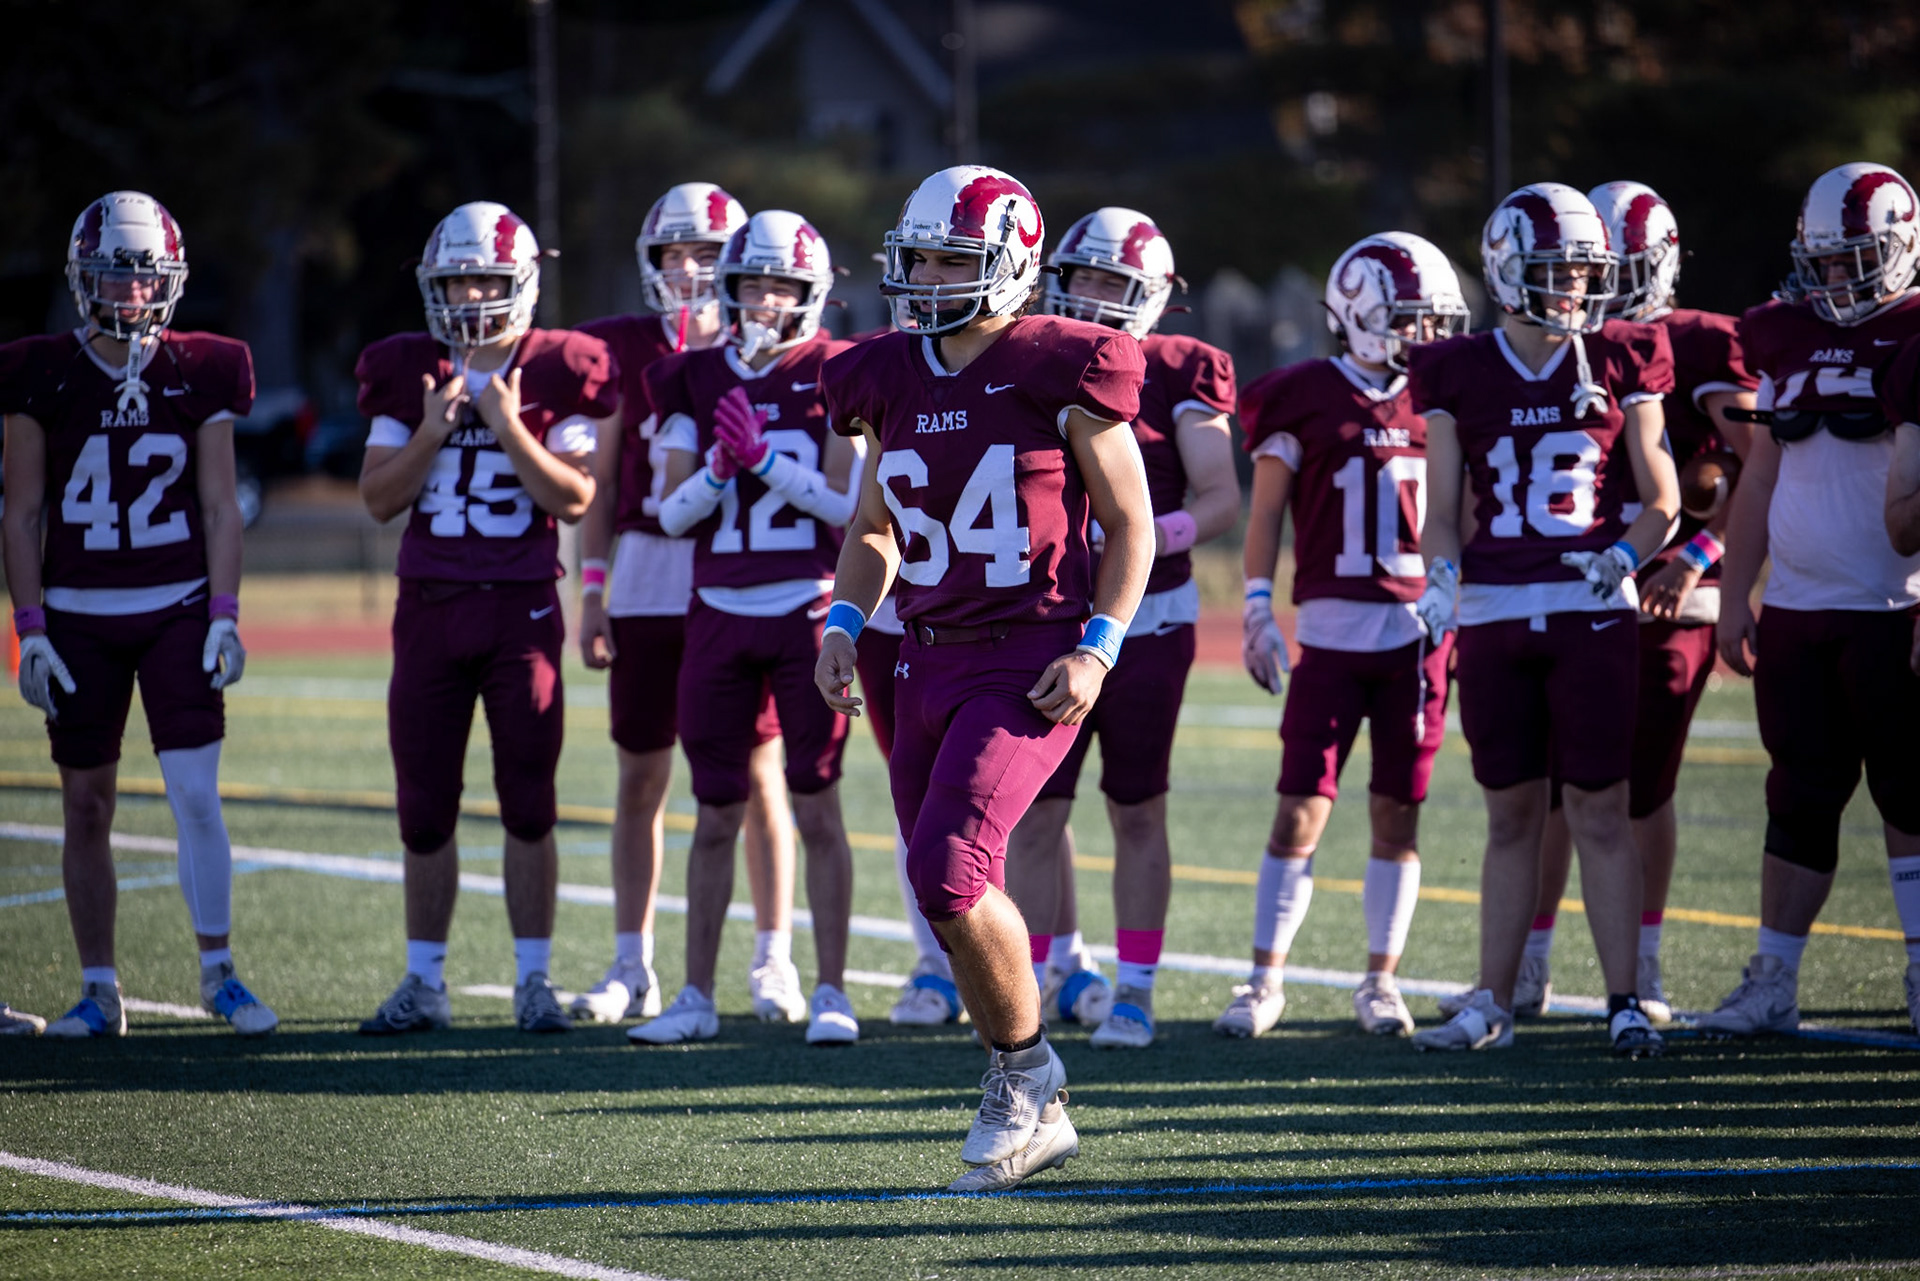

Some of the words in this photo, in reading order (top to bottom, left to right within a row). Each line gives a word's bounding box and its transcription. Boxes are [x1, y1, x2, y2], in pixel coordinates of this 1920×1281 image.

[1808, 348, 1854, 364] RAMS
[101, 408, 150, 428] RAMS
[915, 410, 968, 434] RAMS
[1363, 427, 1411, 447] RAMS
[1510, 406, 1562, 426] RAMS
[61, 433, 190, 550] 42
[419, 447, 533, 537] 45
[705, 429, 819, 554] 12
[876, 444, 1031, 588] 64
[1333, 455, 1428, 577] 10
[1486, 430, 1601, 538] 18
